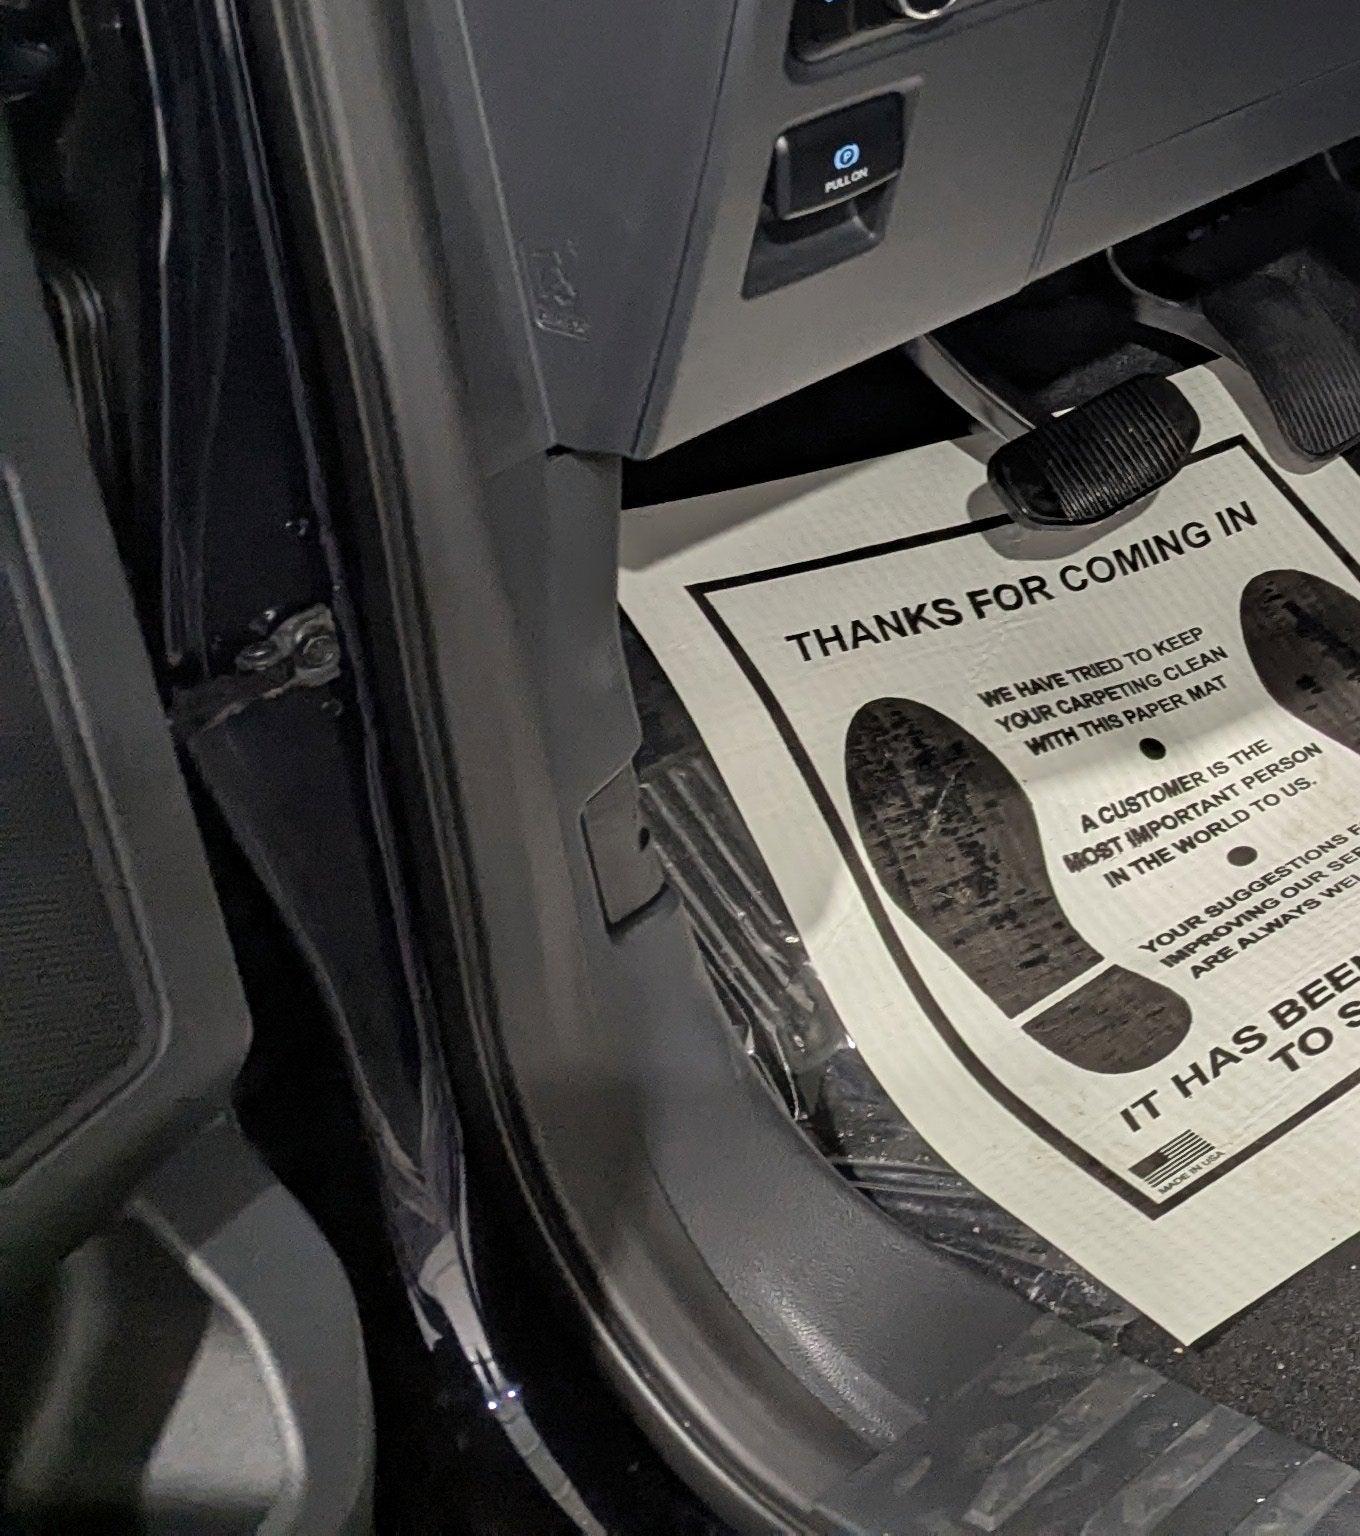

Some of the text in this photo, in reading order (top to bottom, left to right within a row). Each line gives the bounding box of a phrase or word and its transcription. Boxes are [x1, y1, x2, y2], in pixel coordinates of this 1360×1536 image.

[824, 167, 869, 193] PULL ON
[785, 500, 1259, 663] THANKS FOR COMING IN
[977, 626, 1204, 708] WE HAVE TRIED TO KEEP
[995, 645, 1229, 733] YOUR CARPETING CLEAN
[1024, 674, 1229, 756] WITH THIS PAPER MAT
[1062, 742, 1323, 874] MOST IMPORTANT PERSON
[1080, 738, 1274, 834] A CUSTOMER IS THE
[1102, 776, 1319, 889] IN THE WORLD TO US.
[1138, 915, 1207, 954] YOUR
[1203, 834, 1349, 919] SUGGESTIONS
[1159, 897, 1281, 969] IMPROVING
[1280, 869, 1330, 899] OUR
[1190, 945, 1240, 980] ARE
[1237, 897, 1322, 950] ALWAYS
[1119, 1088, 1163, 1134] IT
[1170, 1024, 1269, 1100] HAS
[1268, 1025, 1334, 1074] TO
[1158, 1151, 1225, 1194] MADE IN USA
